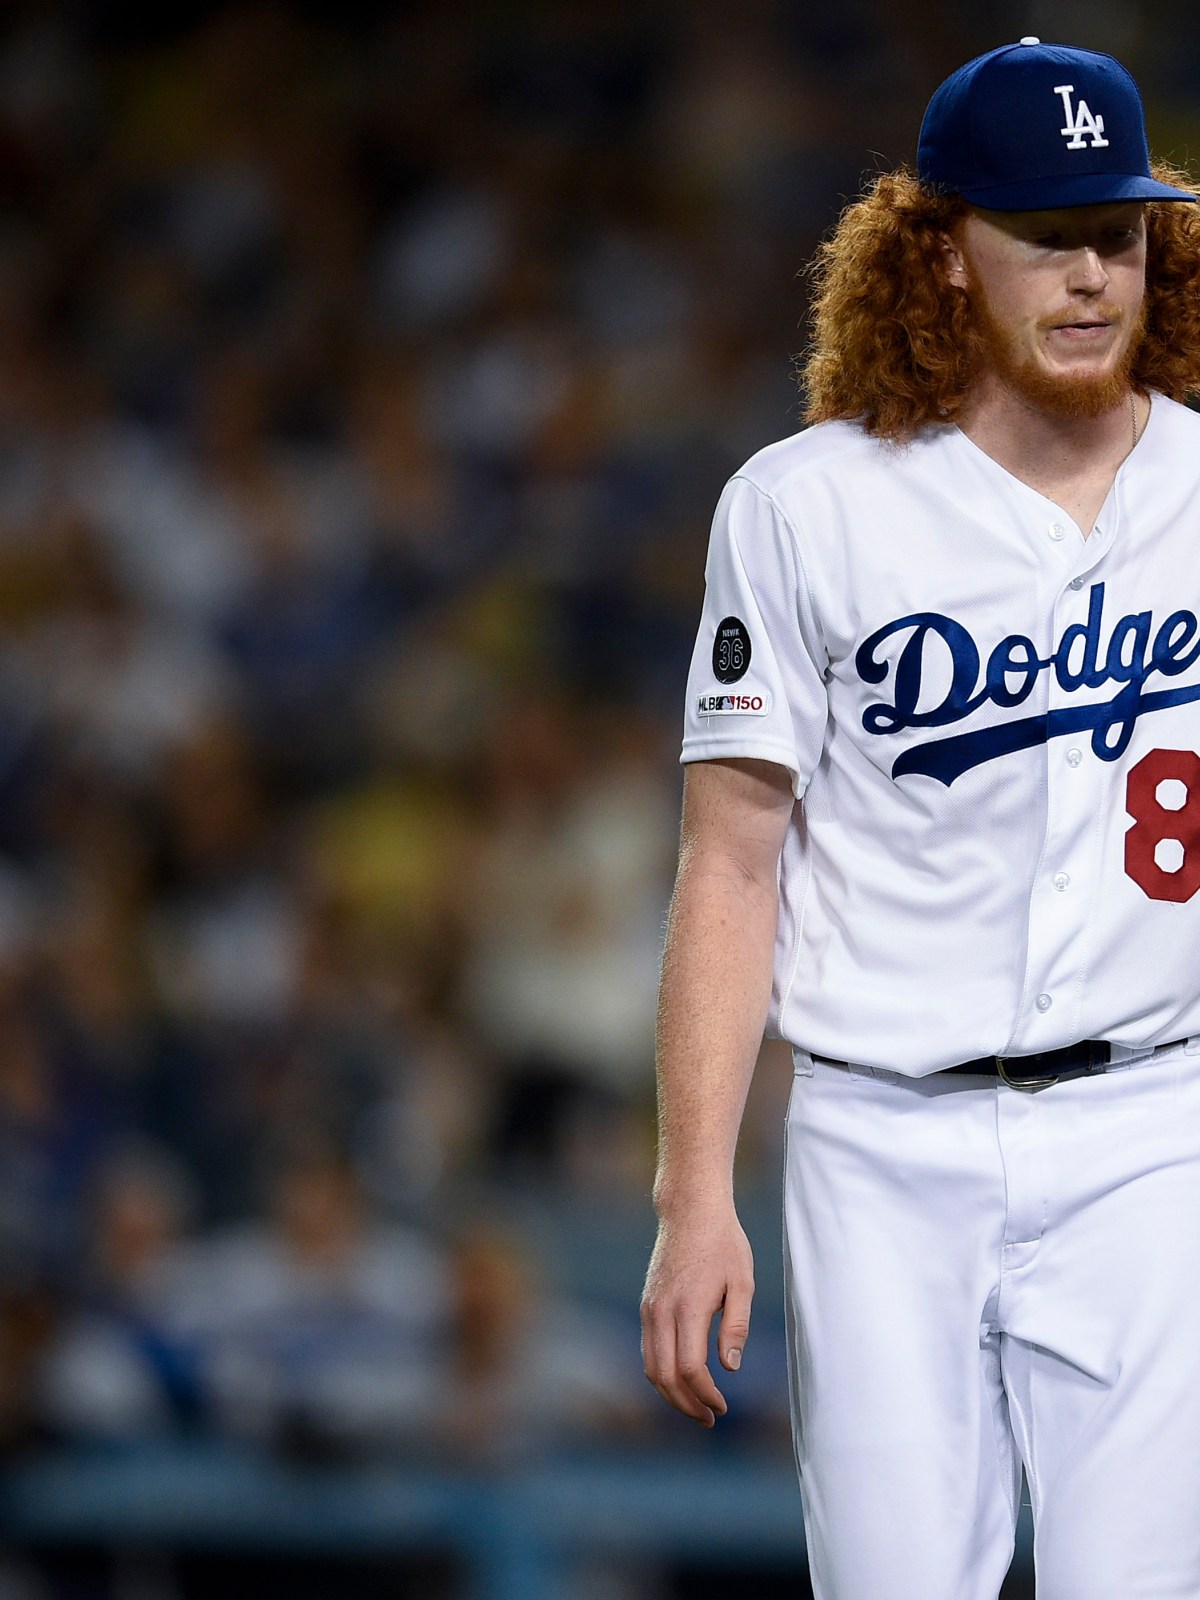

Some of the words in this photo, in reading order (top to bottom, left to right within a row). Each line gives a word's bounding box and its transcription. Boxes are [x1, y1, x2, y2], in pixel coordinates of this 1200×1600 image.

[1053, 84, 1110, 150] LA
[718, 638, 744, 671] 36
[698, 697, 716, 712] MLB
[735, 695, 763, 711] 150
